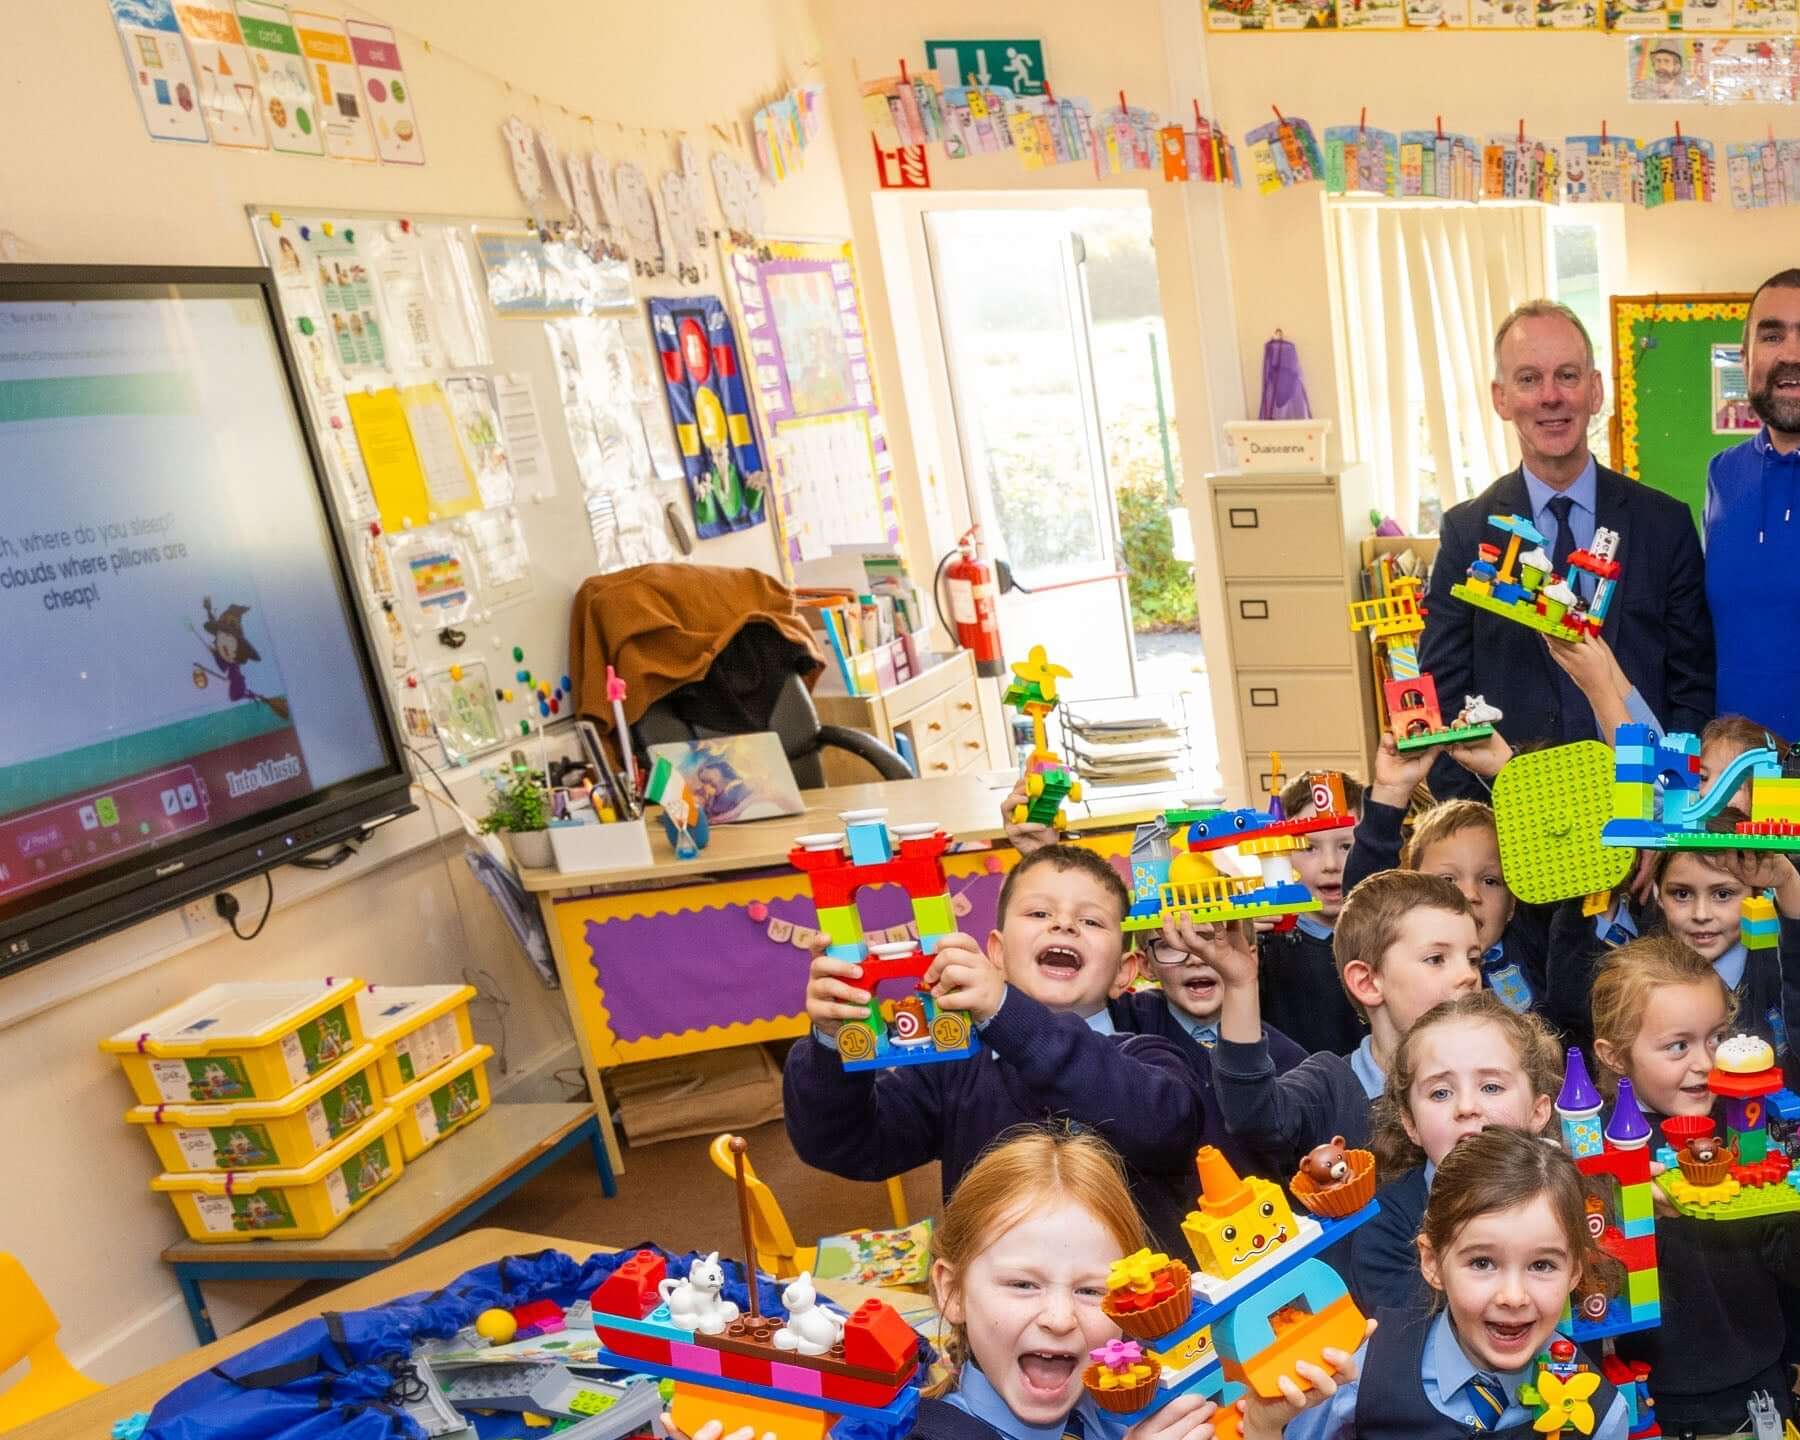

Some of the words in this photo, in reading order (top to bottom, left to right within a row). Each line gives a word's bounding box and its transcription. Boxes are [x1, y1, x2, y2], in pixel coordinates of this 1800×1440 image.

[21, 529, 71, 552] where
[74, 523, 96, 545] do
[98, 520, 129, 547] you
[130, 512, 176, 537] sleep?
[1, 561, 57, 589] clouds
[57, 553, 108, 579] where
[110, 544, 161, 577] pillows
[163, 543, 188, 560] are
[43, 583, 101, 611] cheap!
[227, 768, 260, 798] Into
[257, 754, 301, 789] Music
[1745, 1102, 1761, 1127] 9
